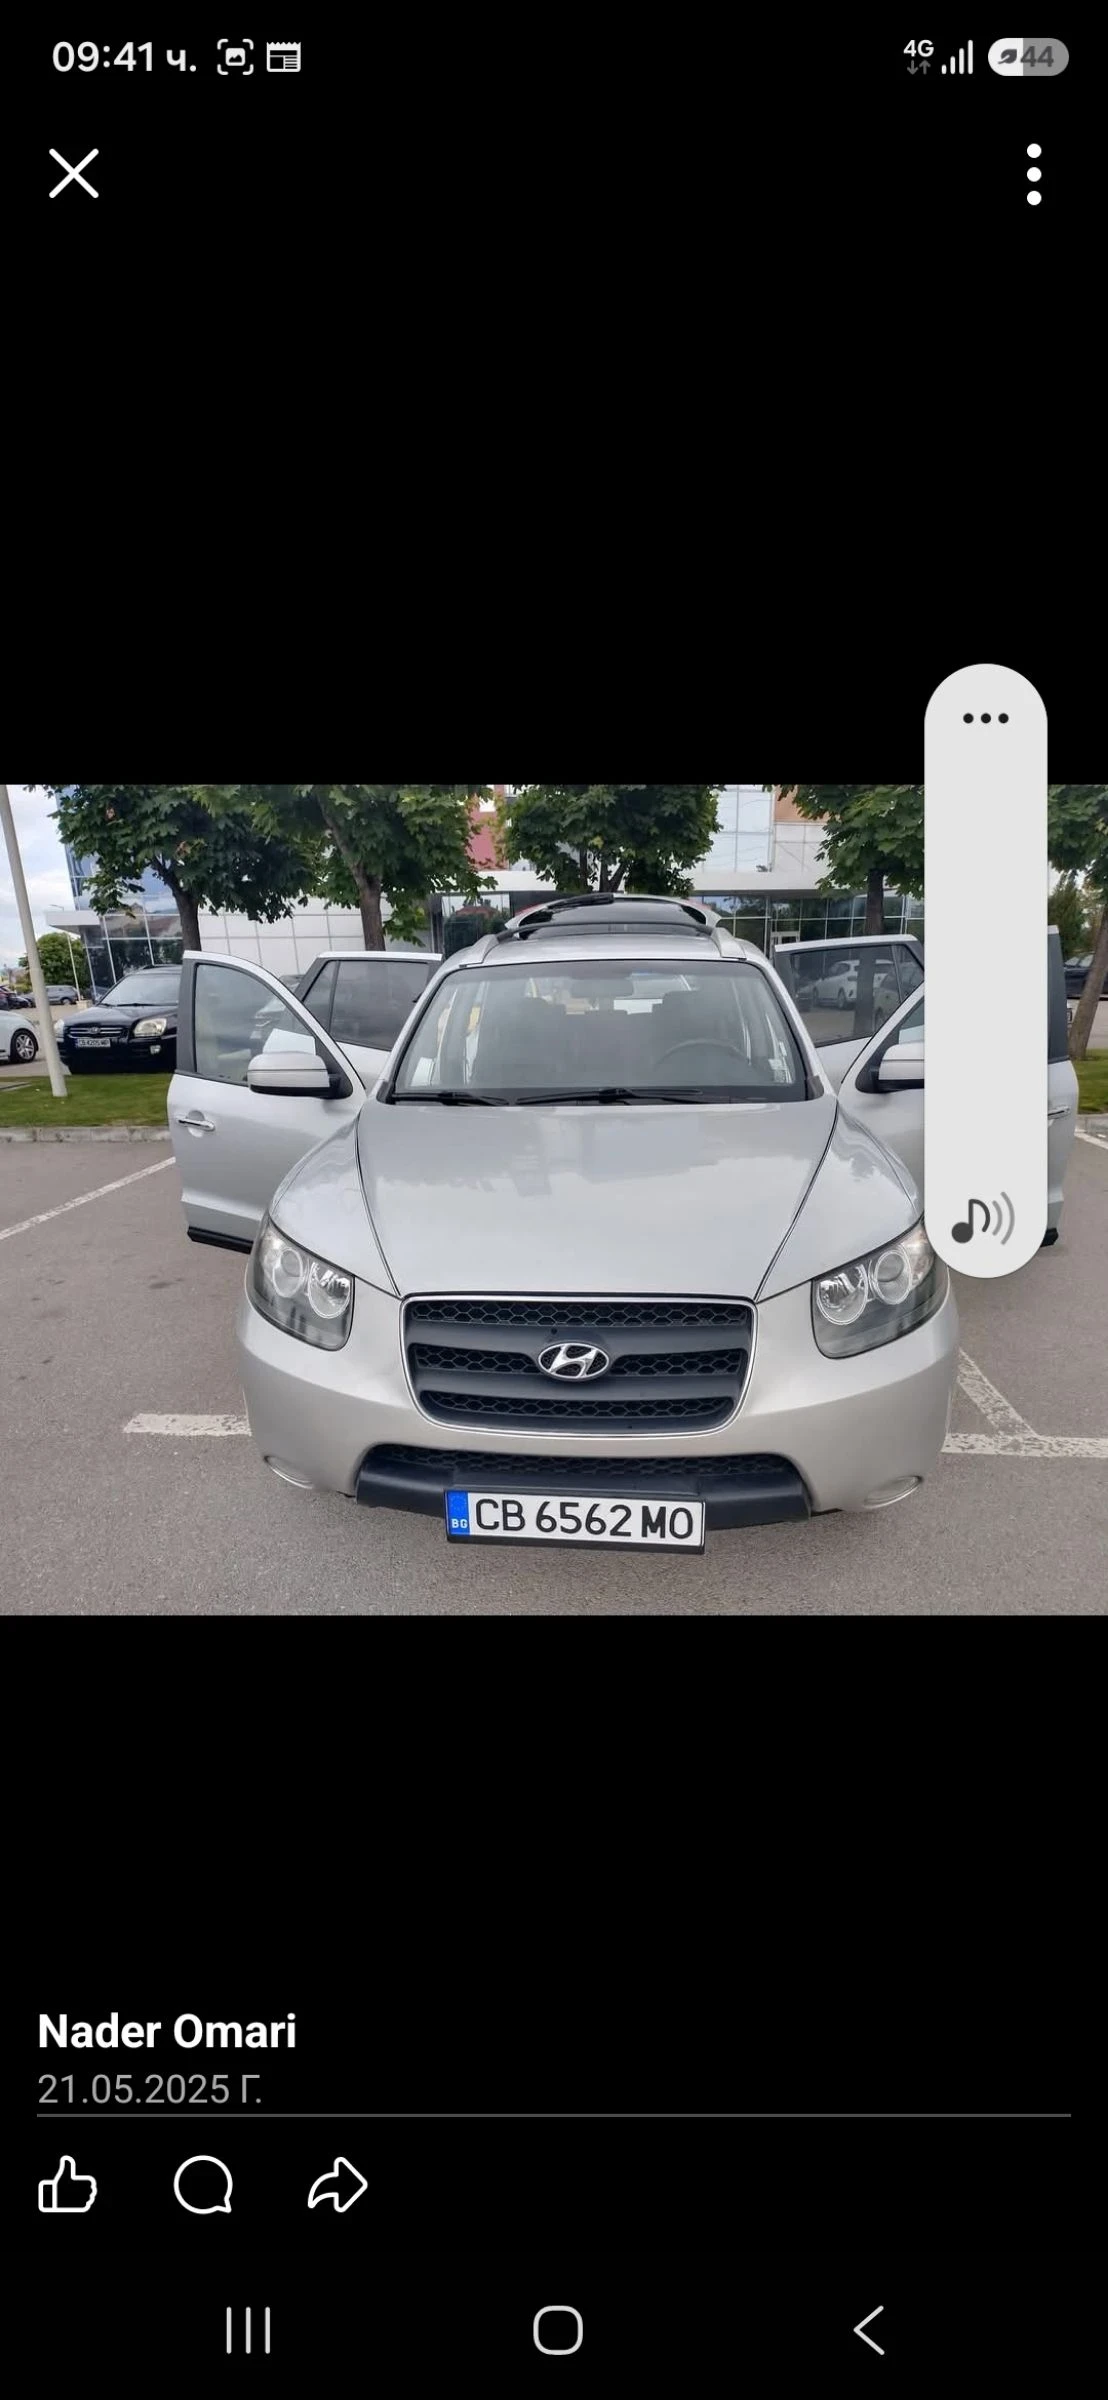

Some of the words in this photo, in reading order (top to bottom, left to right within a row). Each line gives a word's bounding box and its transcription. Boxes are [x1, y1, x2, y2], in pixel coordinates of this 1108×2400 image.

[450, 1517, 469, 1530] BG
[475, 1498, 526, 1532] CB
[535, 1500, 633, 1538] 6562
[641, 1505, 694, 1540] MO
